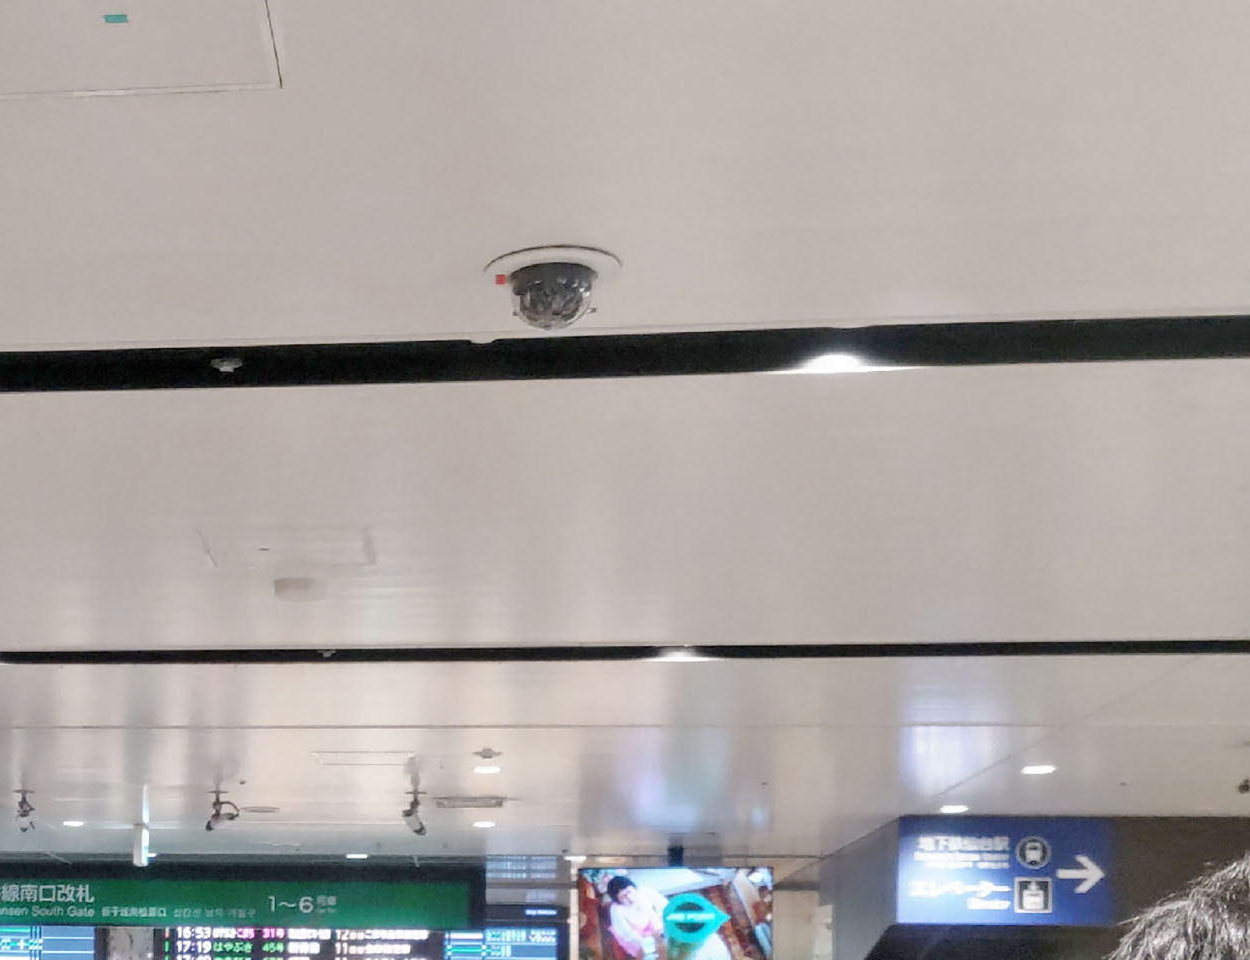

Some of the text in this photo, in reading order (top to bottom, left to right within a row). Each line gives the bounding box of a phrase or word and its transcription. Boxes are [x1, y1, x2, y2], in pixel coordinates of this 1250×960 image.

[31, 906, 64, 917] South
[67, 906, 95, 917] Gate
[176, 942, 212, 954] 17:19
